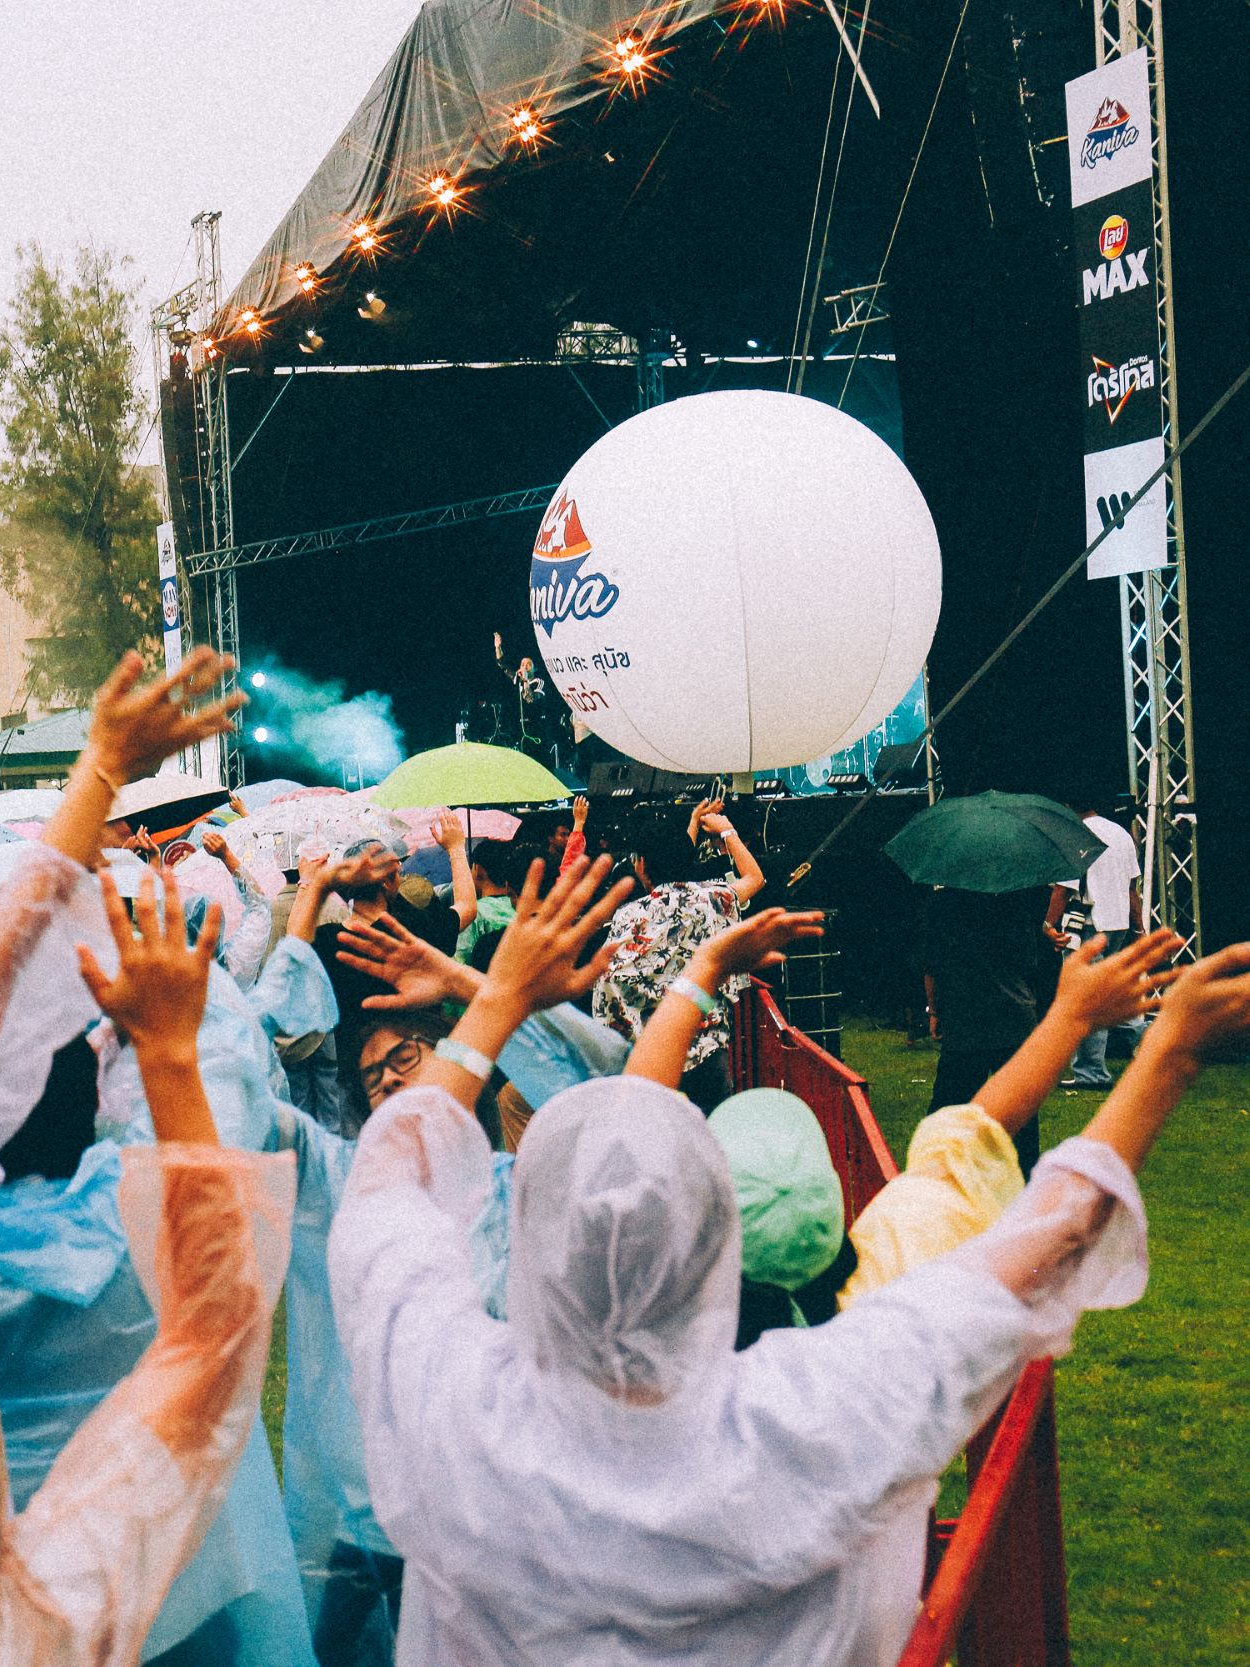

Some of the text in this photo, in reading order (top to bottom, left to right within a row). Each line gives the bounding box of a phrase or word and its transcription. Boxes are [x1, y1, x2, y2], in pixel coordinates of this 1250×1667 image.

[1081, 125, 1139, 169] Kaniva
[1082, 247, 1151, 305] MAX
[592, 646, 630, 677] สุนัข
